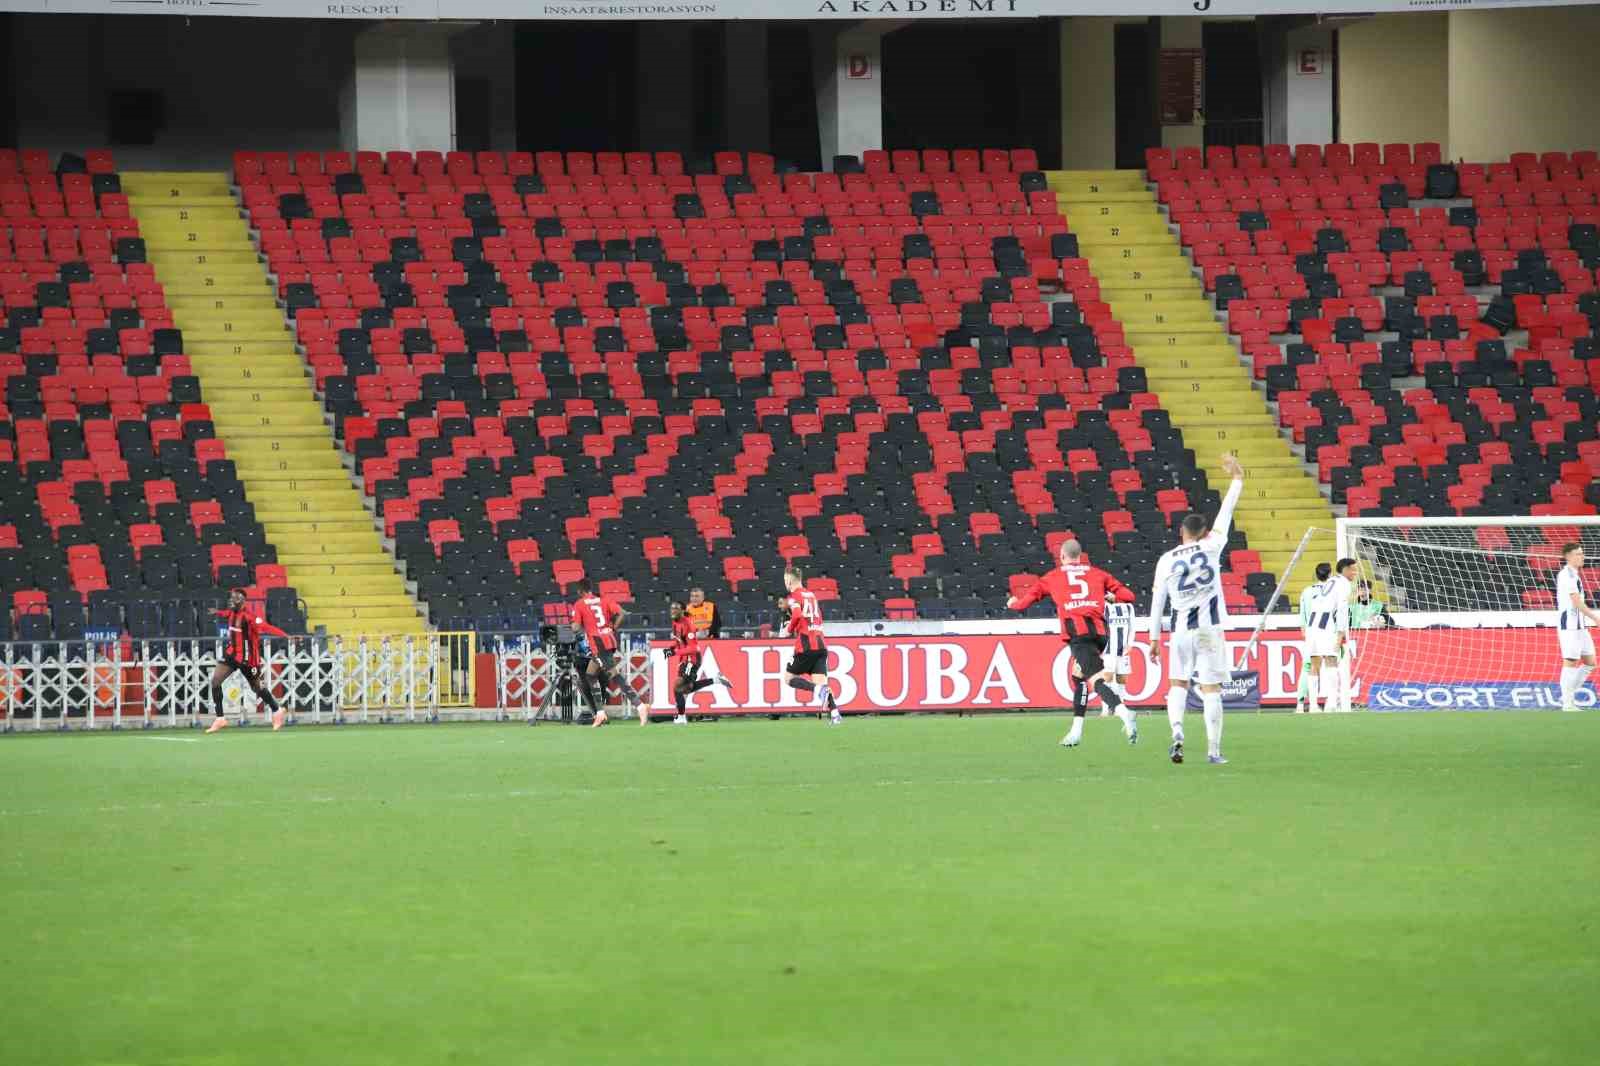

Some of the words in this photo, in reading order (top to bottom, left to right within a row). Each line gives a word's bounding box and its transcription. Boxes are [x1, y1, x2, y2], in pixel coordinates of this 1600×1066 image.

[327, 5, 401, 15] RESORT
[850, 55, 868, 77] D
[1300, 50, 1318, 73] E
[1169, 552, 1215, 591] 23
[1066, 570, 1089, 600] 5
[590, 604, 607, 628] 3
